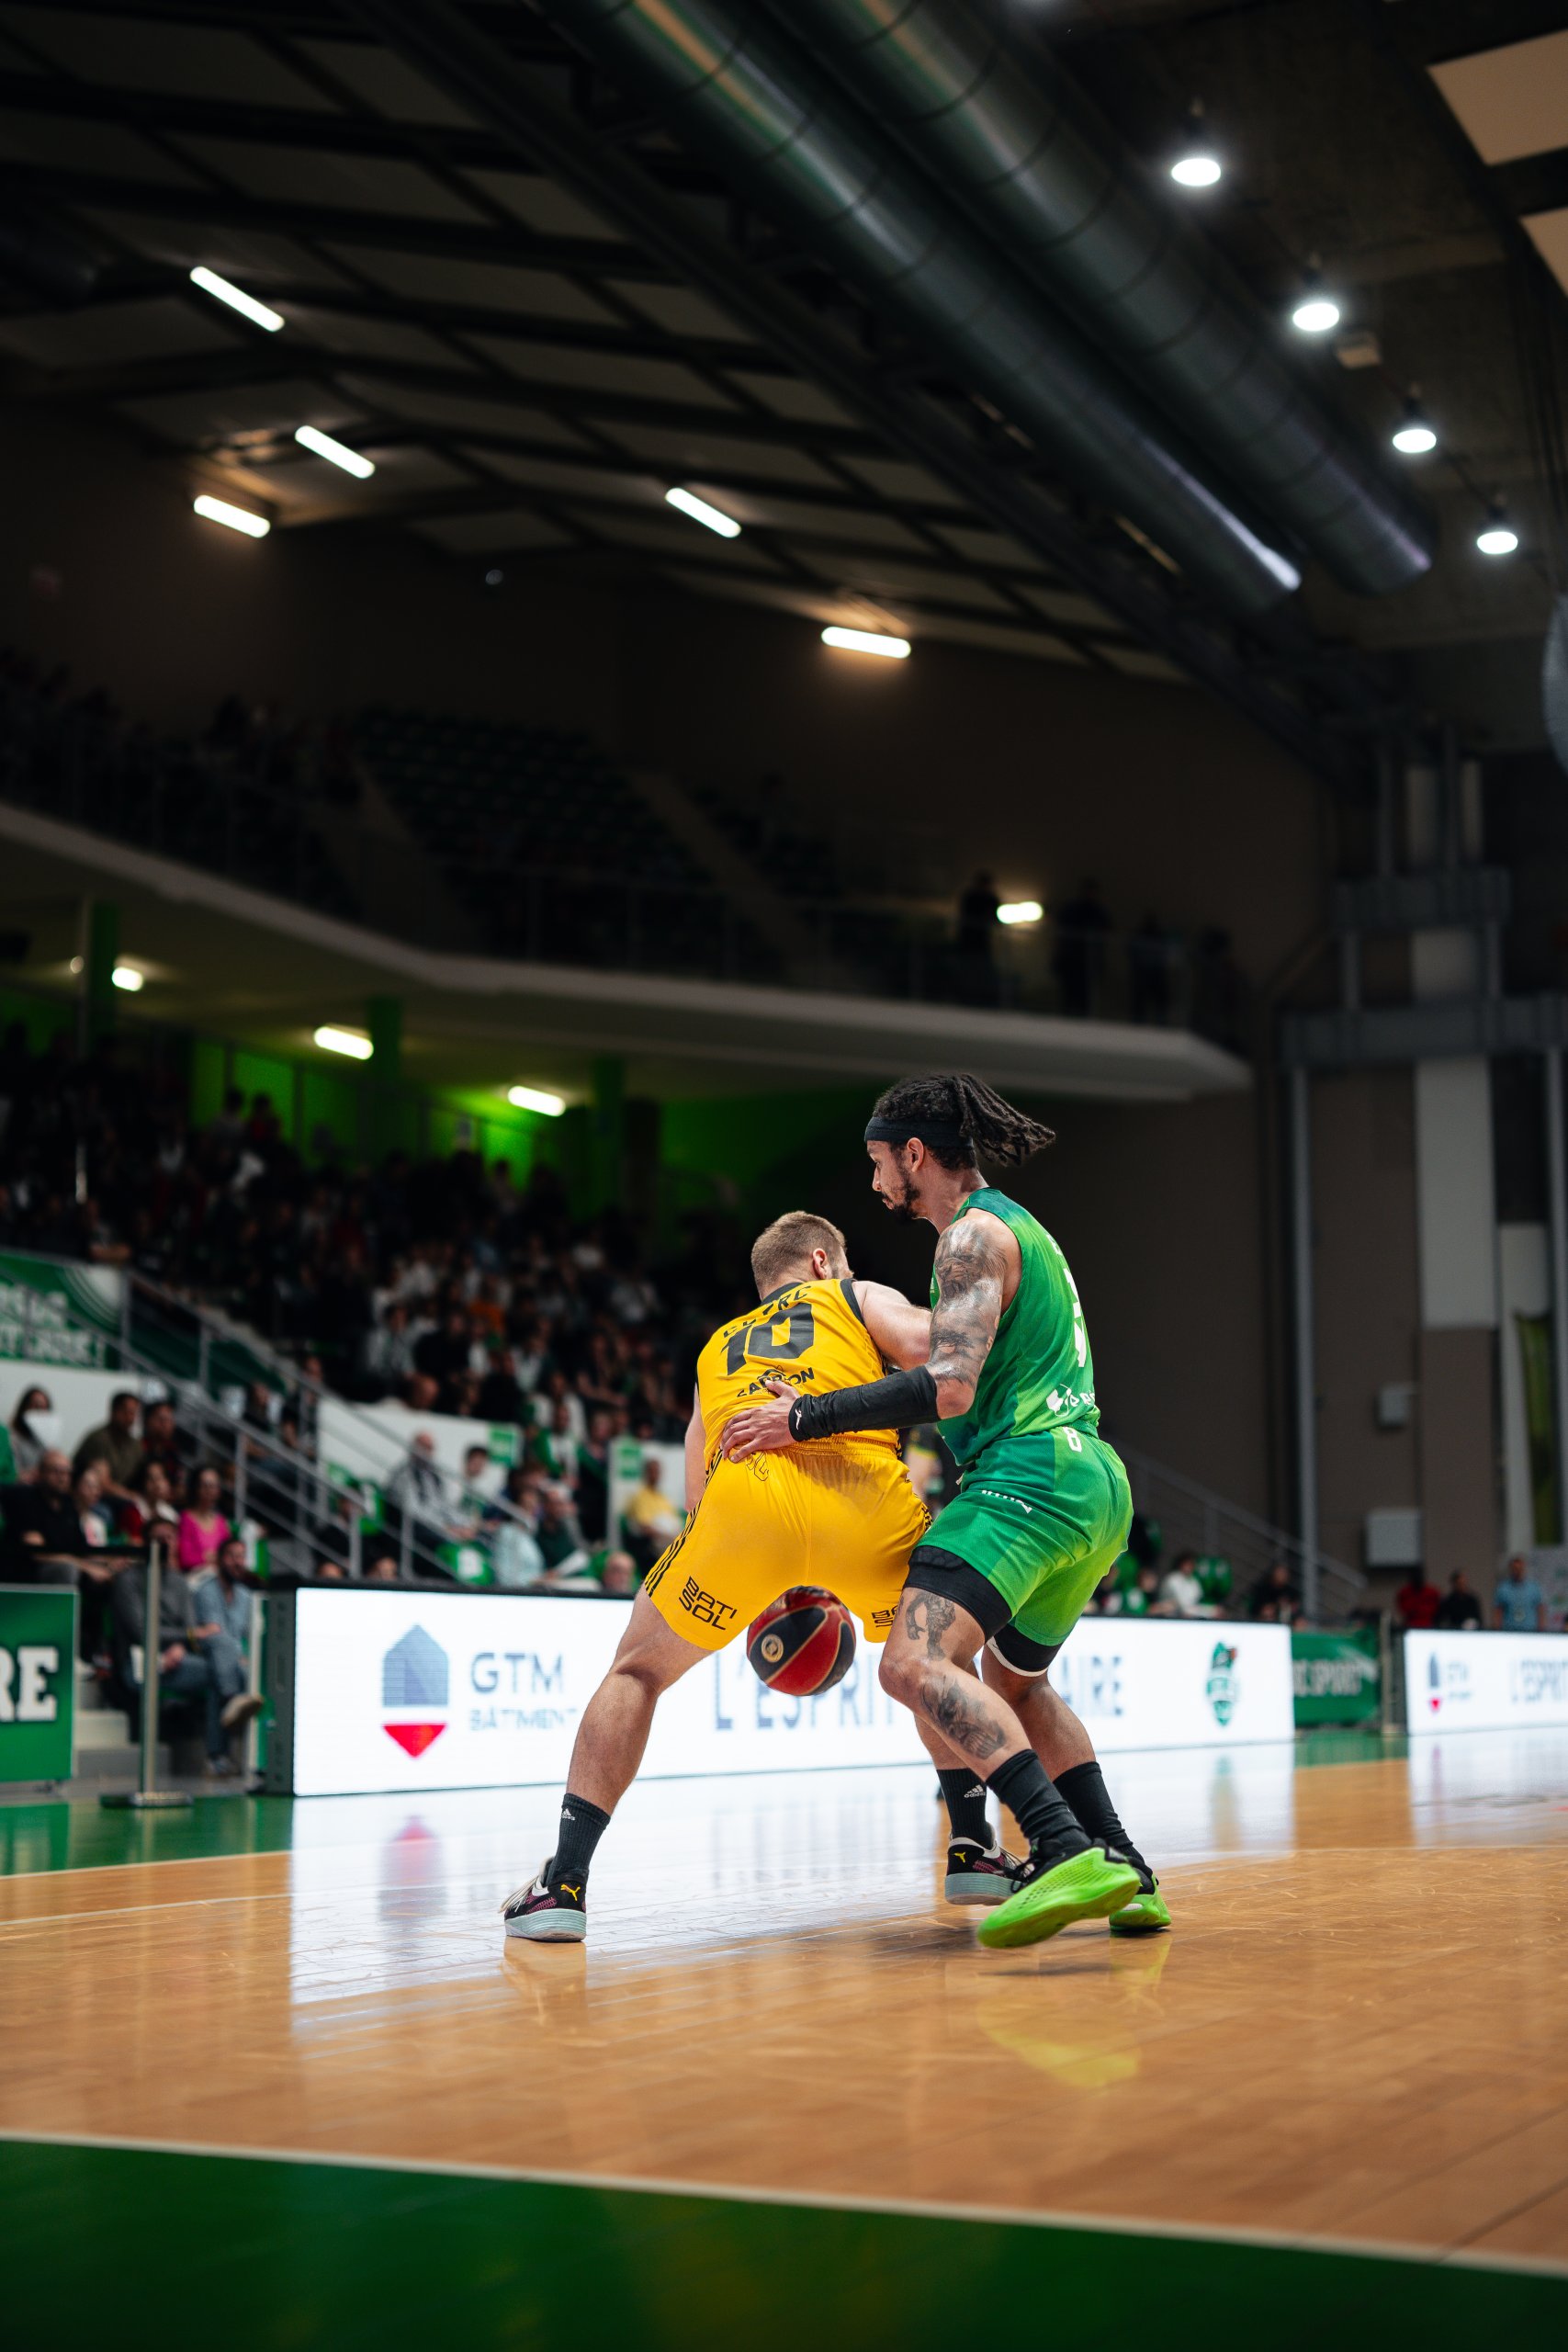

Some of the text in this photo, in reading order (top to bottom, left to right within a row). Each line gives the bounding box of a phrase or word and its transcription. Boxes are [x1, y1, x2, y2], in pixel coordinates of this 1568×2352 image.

[720, 1302, 815, 1376] 10
[1062, 1426, 1083, 1453] 8
[678, 1588, 727, 1631] SOL
[685, 1575, 739, 1620] BATI
[469, 1652, 563, 1693] GTM
